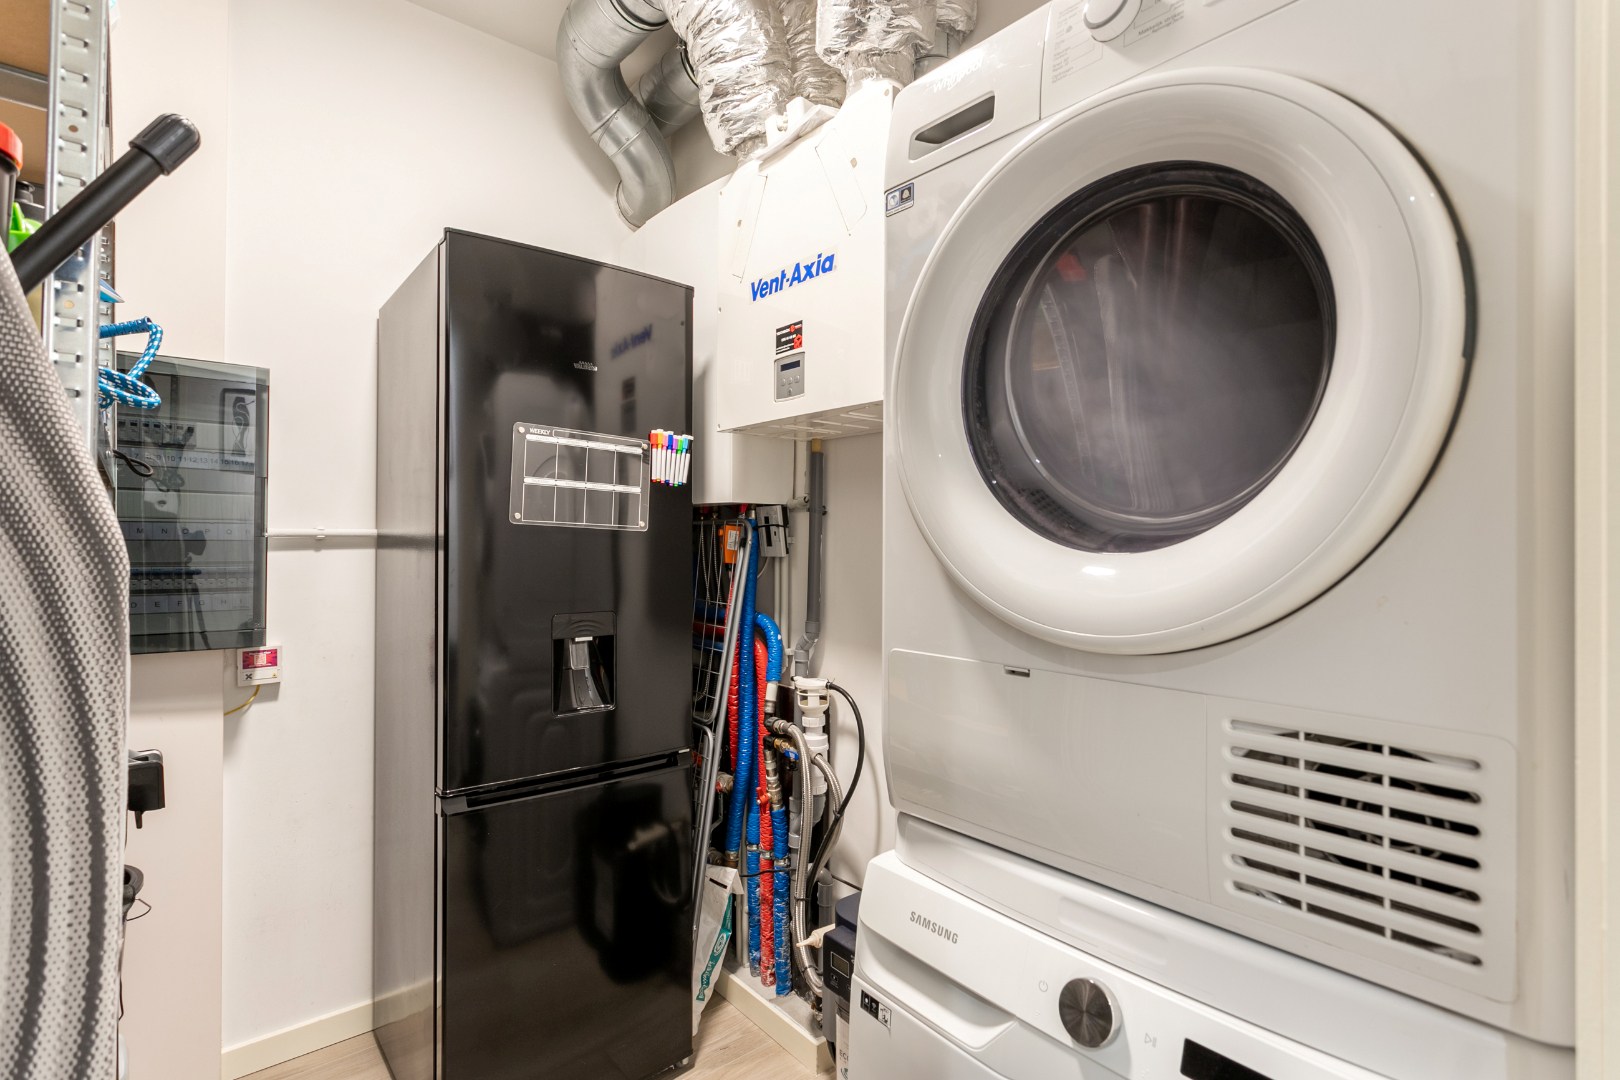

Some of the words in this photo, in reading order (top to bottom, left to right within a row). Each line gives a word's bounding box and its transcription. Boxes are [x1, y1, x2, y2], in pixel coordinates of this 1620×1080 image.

[750, 252, 835, 302] Vent-Axia
[529, 427, 551, 436] WEEKLY
[909, 911, 959, 944] SAMSUNG
